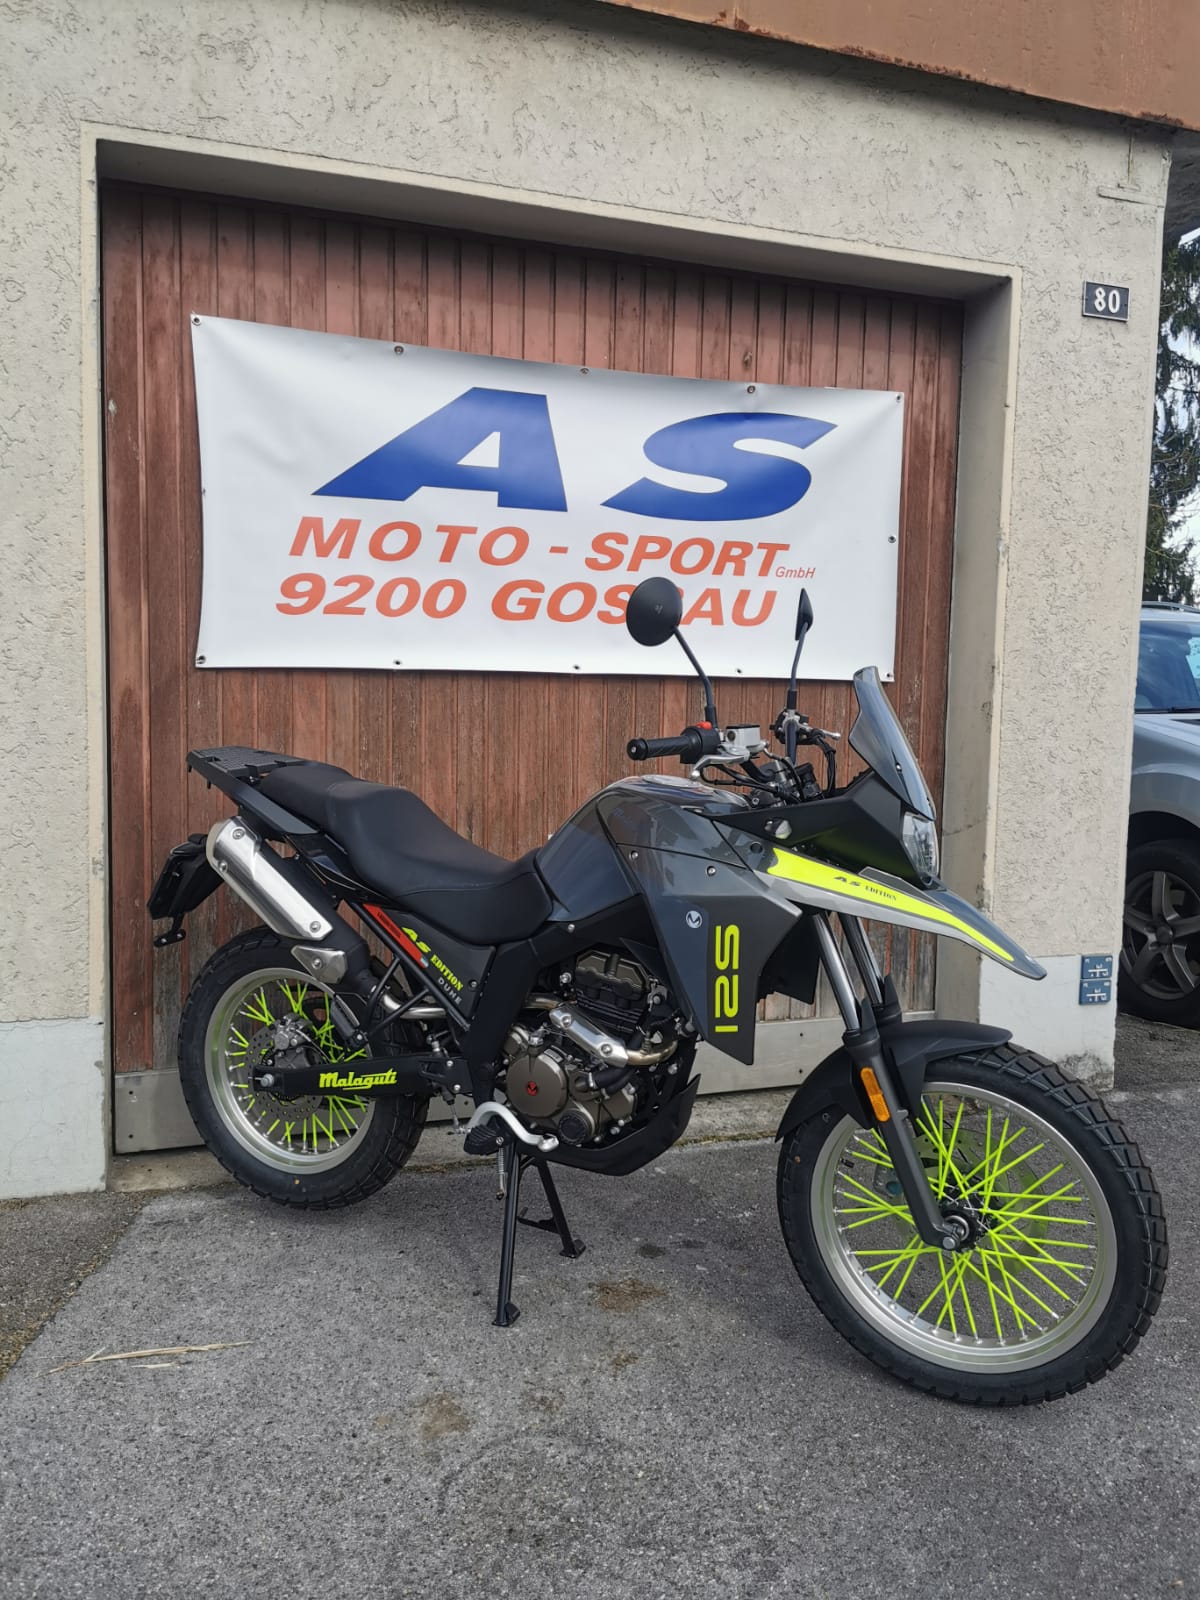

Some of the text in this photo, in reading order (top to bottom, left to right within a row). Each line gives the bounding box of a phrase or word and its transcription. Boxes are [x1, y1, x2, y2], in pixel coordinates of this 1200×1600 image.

[1094, 287, 1121, 314] 80
[288, 516, 530, 567] MOTO
[584, 532, 791, 578] SPORT
[775, 567, 817, 579] GmbH
[275, 572, 778, 627] 9200 GOSAU
[864, 885, 898, 902] EDITION
[401, 926, 464, 992] AS EDITION
[714, 924, 740, 1033] 125
[437, 976, 463, 1006] DUNE
[318, 1067, 398, 1092] Malaguti
